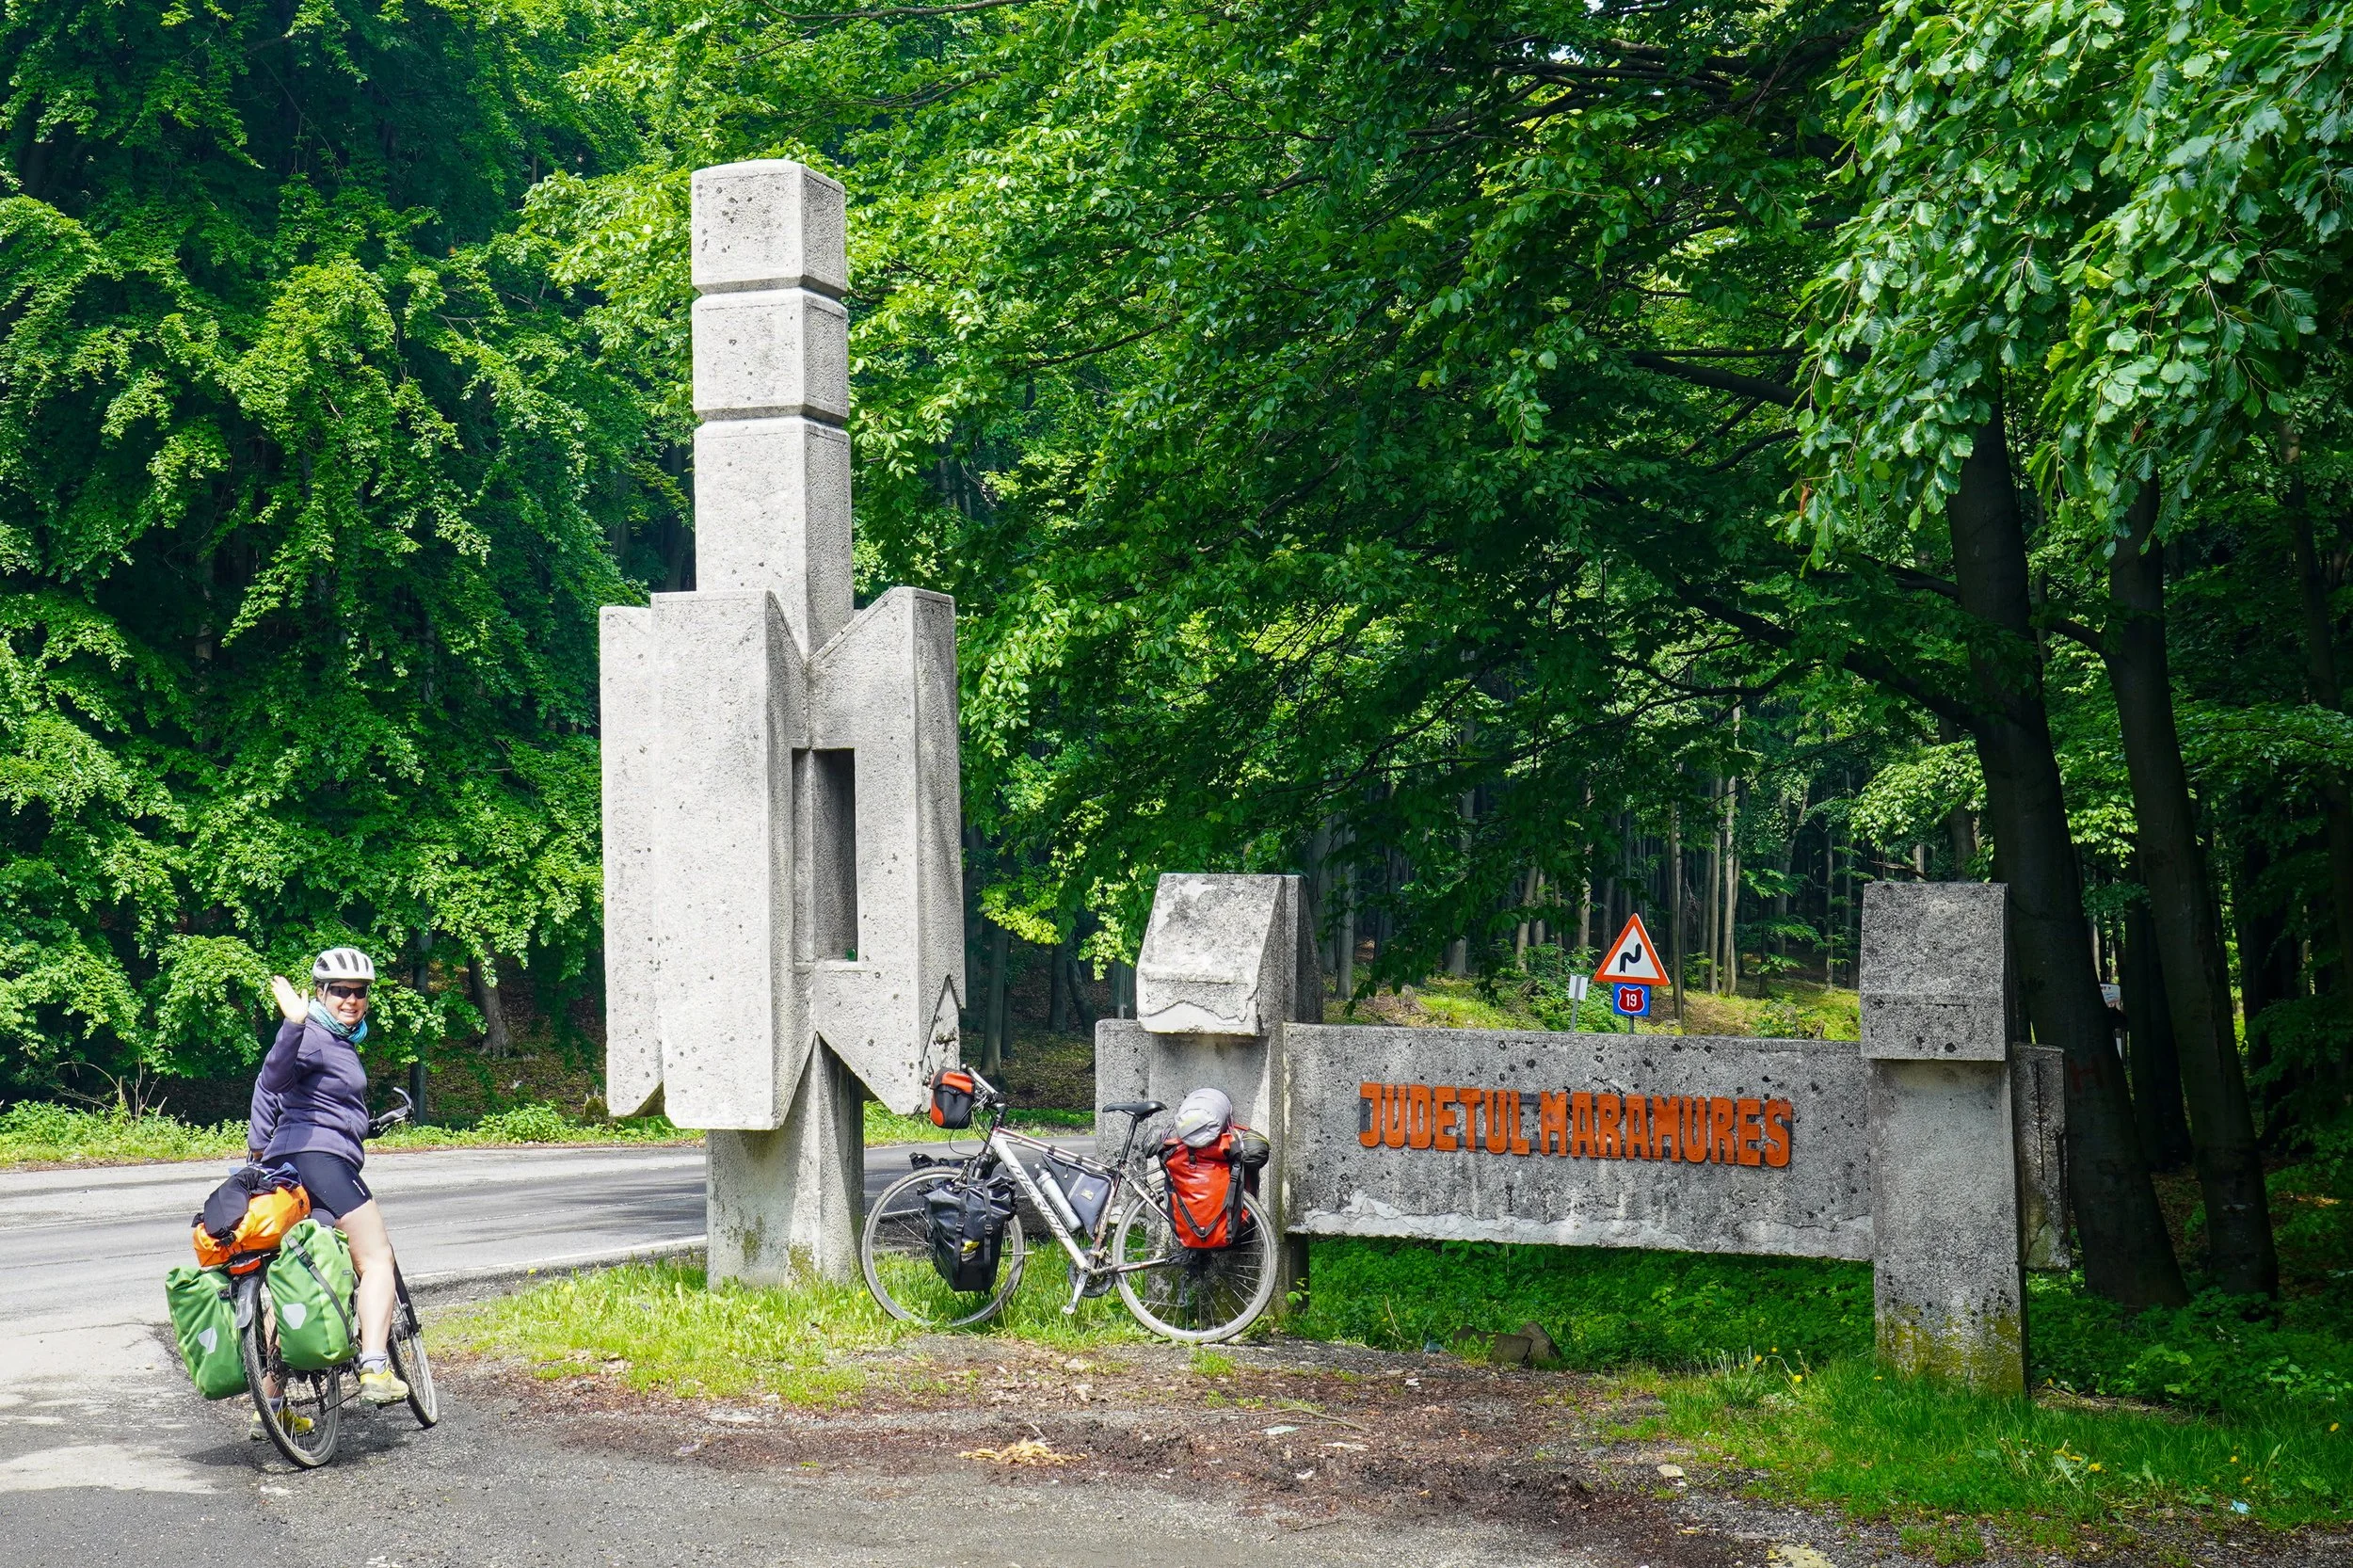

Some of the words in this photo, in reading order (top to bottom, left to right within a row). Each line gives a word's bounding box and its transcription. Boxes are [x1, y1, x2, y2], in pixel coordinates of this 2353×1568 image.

[1625, 993, 1638, 1007] 19
[1359, 1082, 1530, 1155] JUDETUL
[1540, 1090, 1793, 1168] MARAMURES
